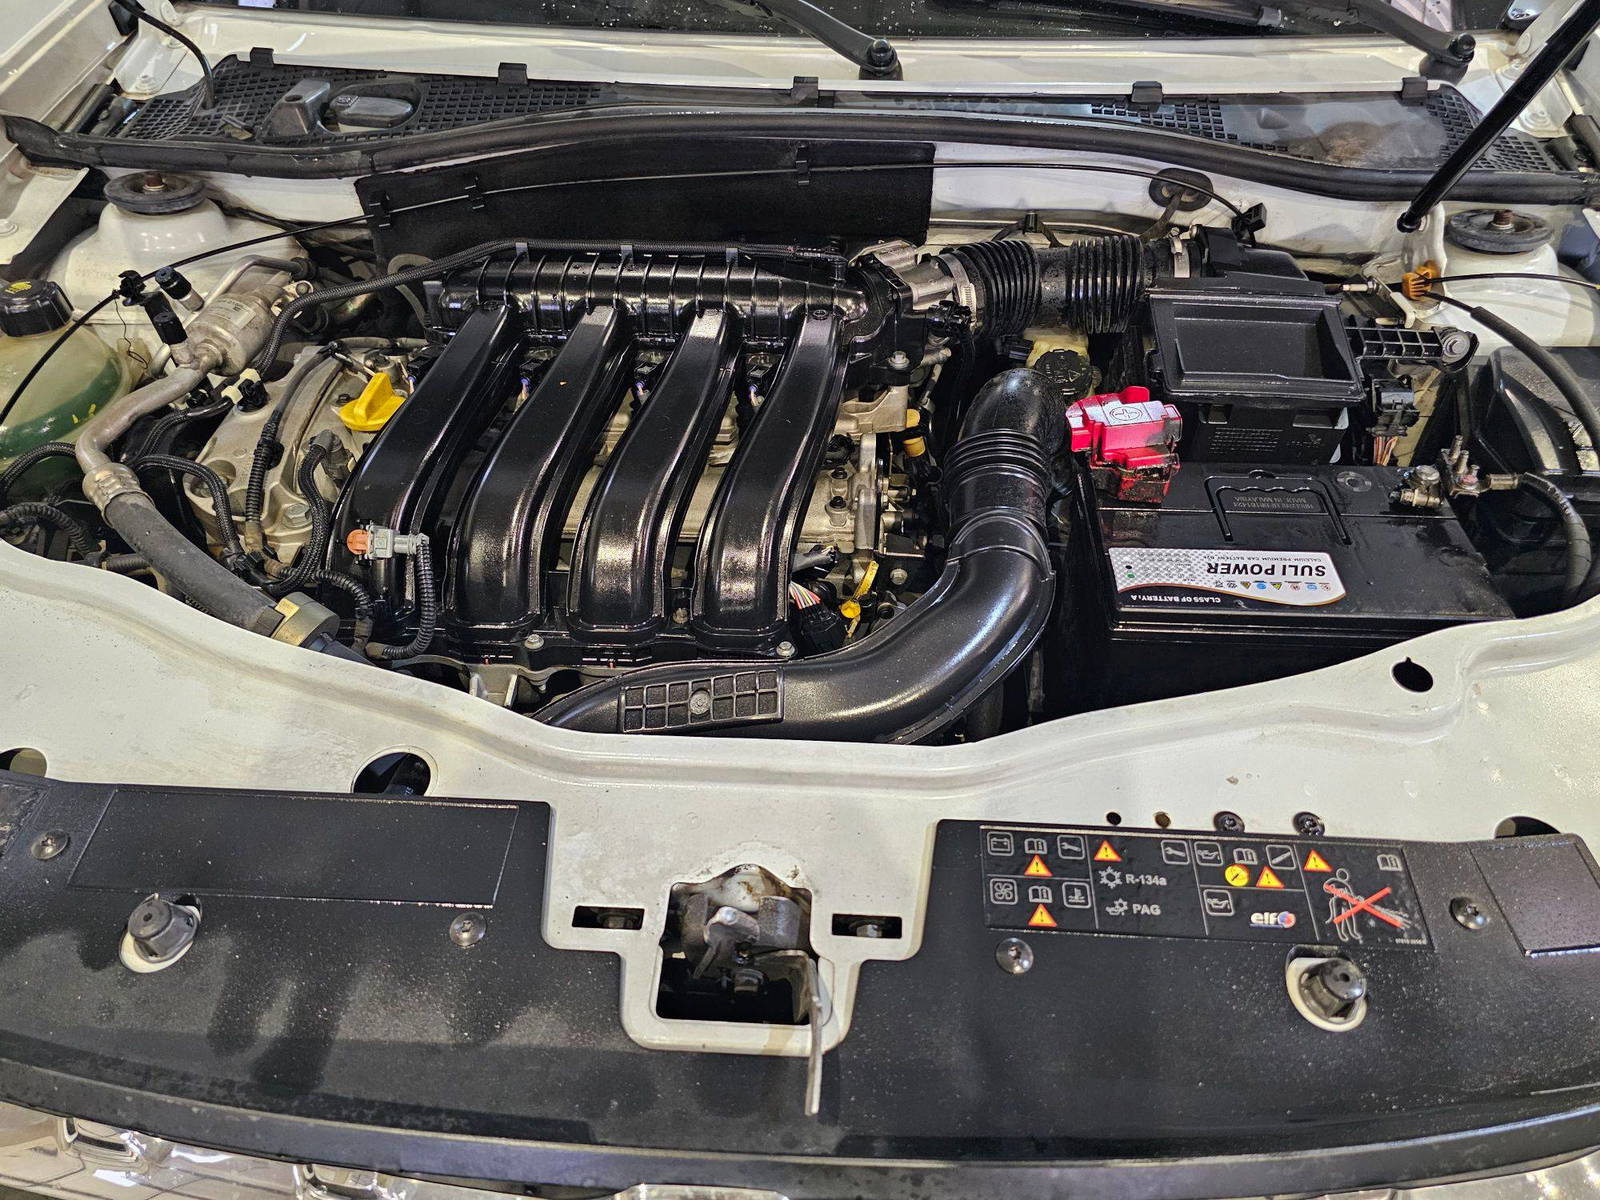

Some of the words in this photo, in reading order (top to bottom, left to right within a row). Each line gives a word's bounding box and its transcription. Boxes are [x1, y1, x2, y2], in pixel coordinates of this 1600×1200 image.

[1206, 562, 1276, 576] POWER
[1281, 563, 1326, 577] SULI
[1125, 873, 1168, 886] R-134a
[1132, 903, 1161, 916] PAG
[1250, 911, 1279, 925] elf
